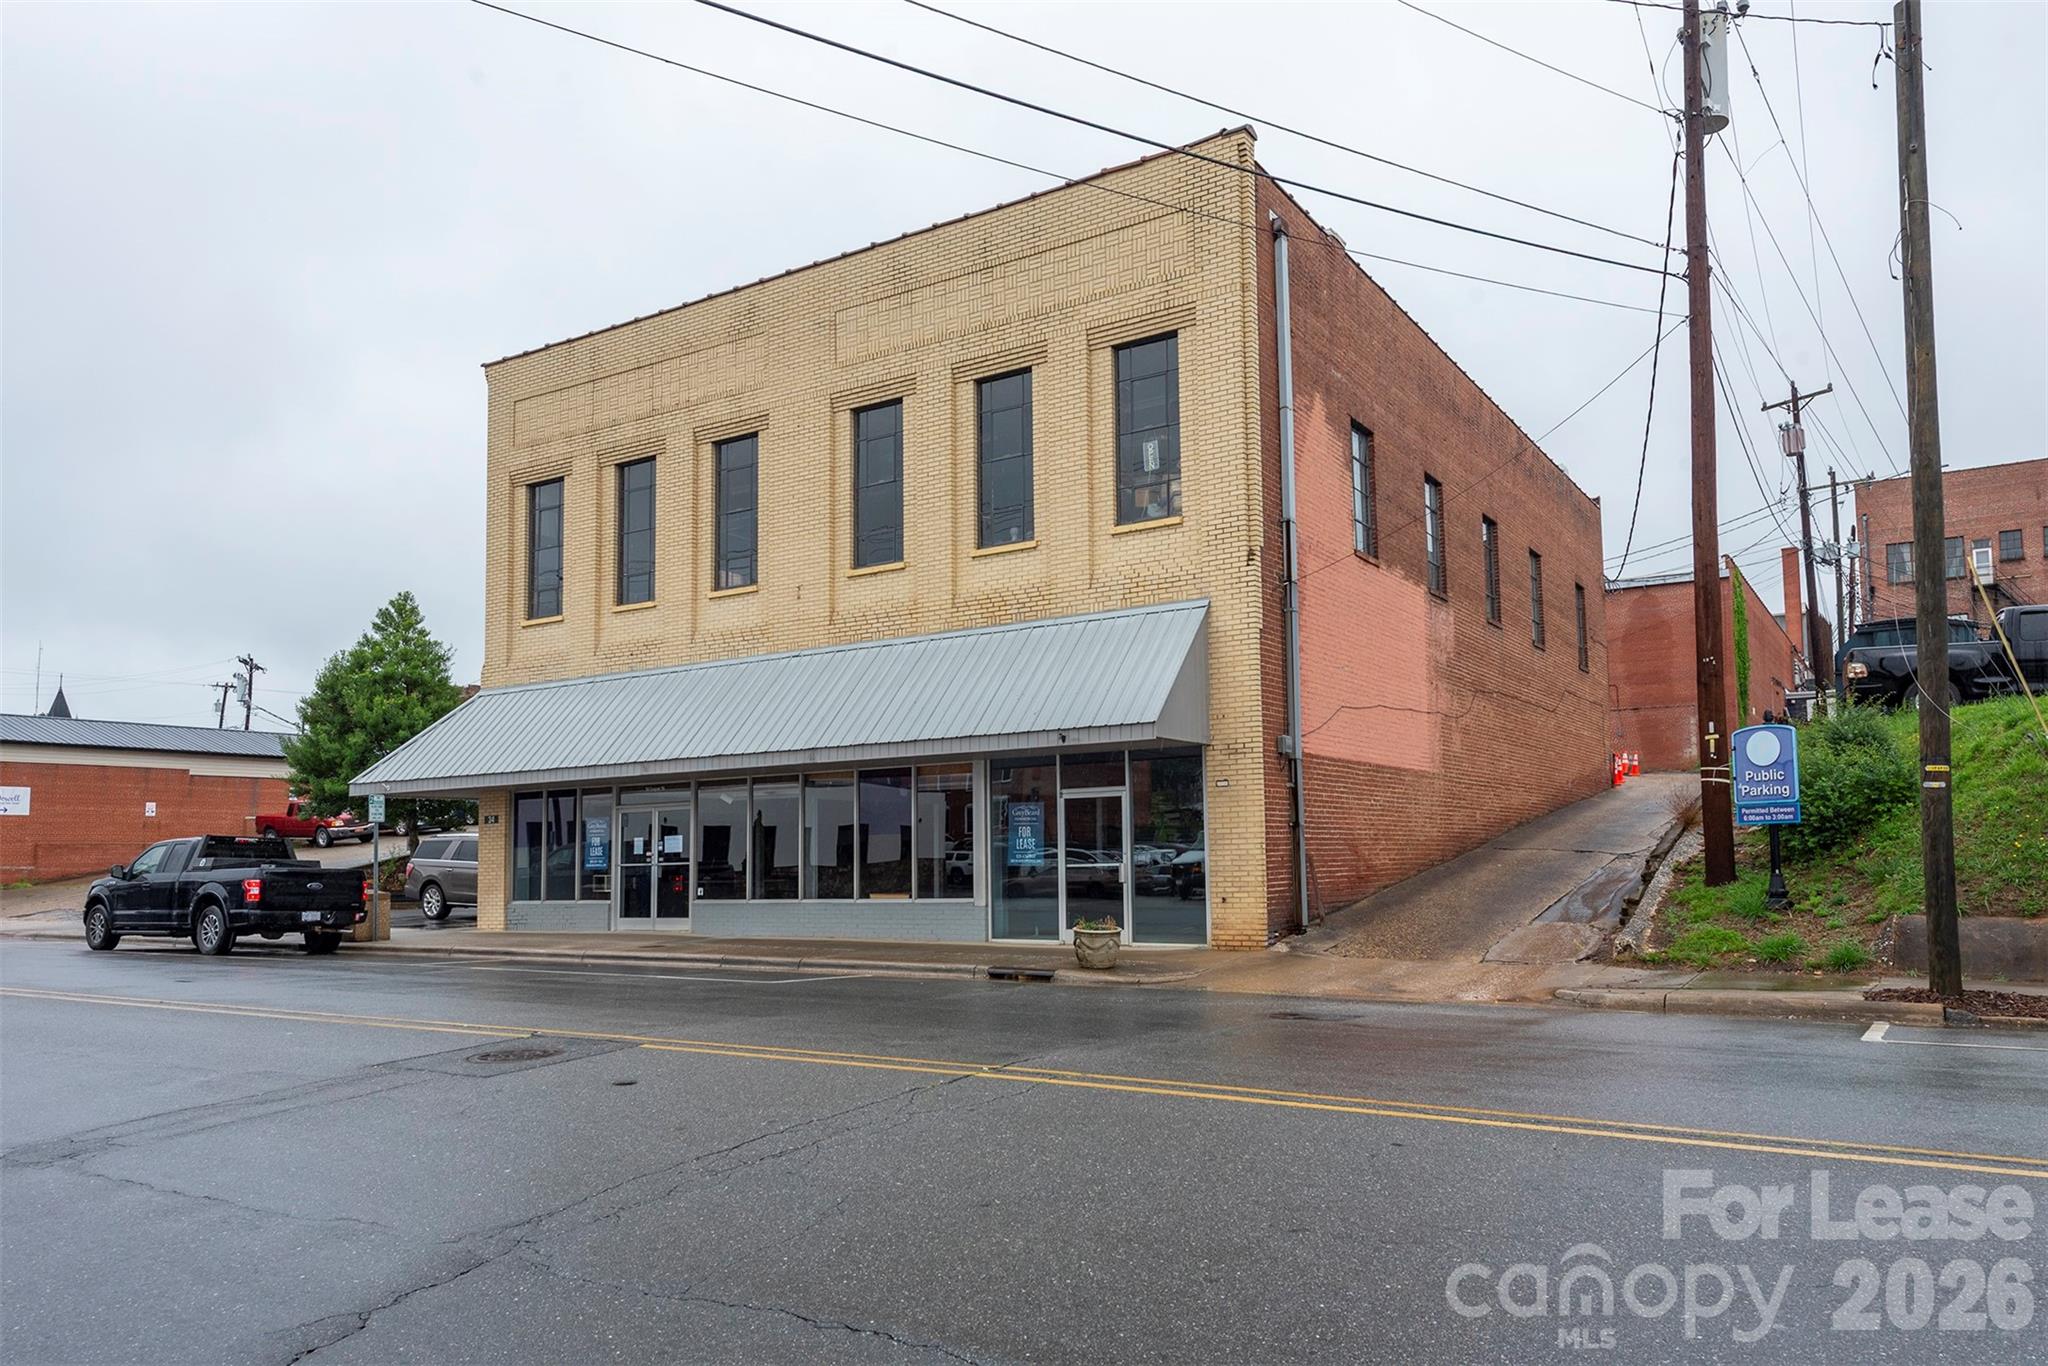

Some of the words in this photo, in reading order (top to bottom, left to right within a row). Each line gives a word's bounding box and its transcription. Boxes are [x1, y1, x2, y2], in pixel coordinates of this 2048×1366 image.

[1745, 769, 1785, 782] Public
[1741, 784, 1790, 797] Parking
[1018, 826, 1031, 838] FOR
[1016, 838, 1036, 850] LEASE
